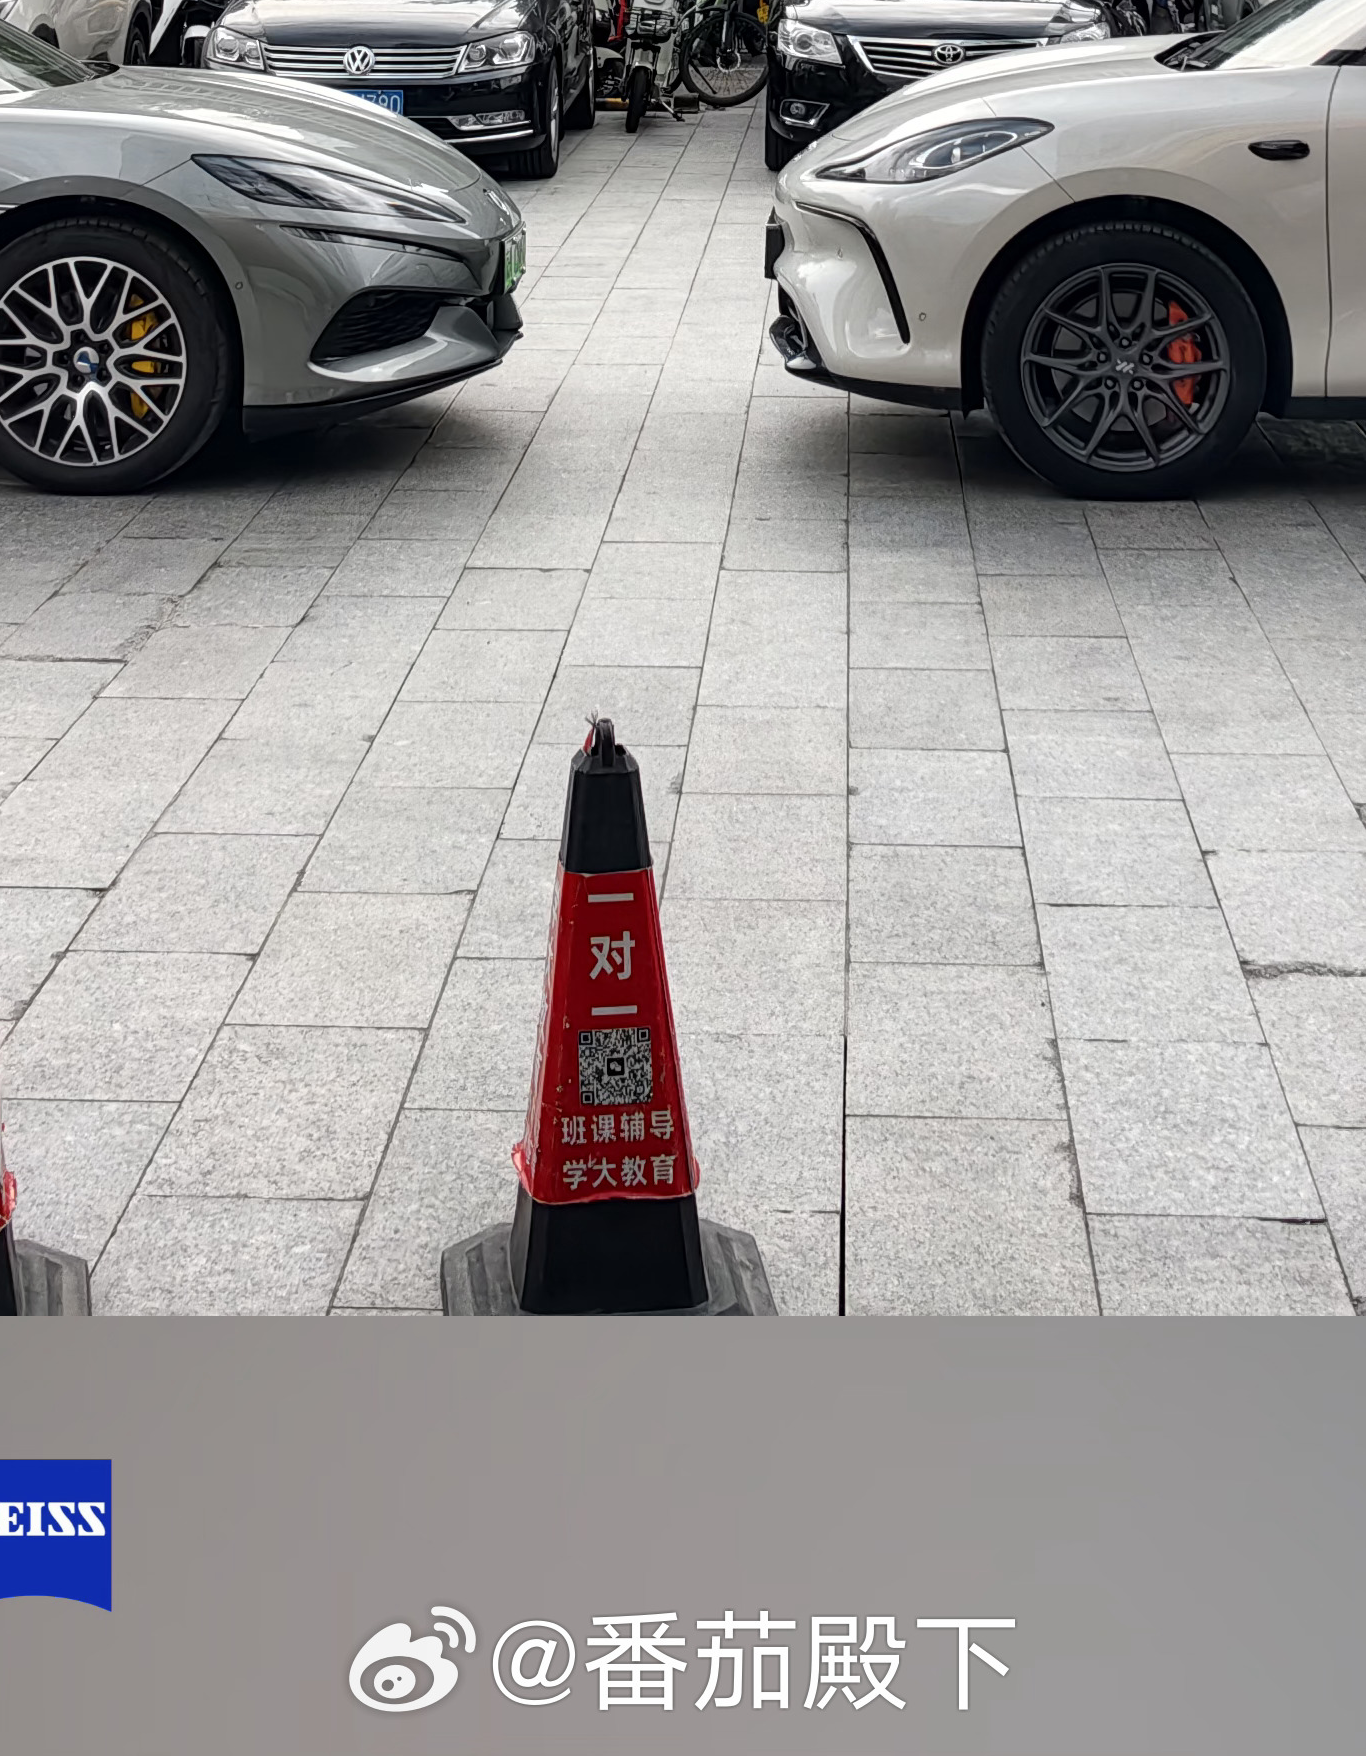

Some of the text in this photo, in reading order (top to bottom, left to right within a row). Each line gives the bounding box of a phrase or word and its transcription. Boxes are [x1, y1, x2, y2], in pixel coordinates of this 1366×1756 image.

[588, 892, 638, 1016] 一对一
[561, 1109, 676, 1147] 班课辅导
[562, 1154, 677, 1191] 学大教育
